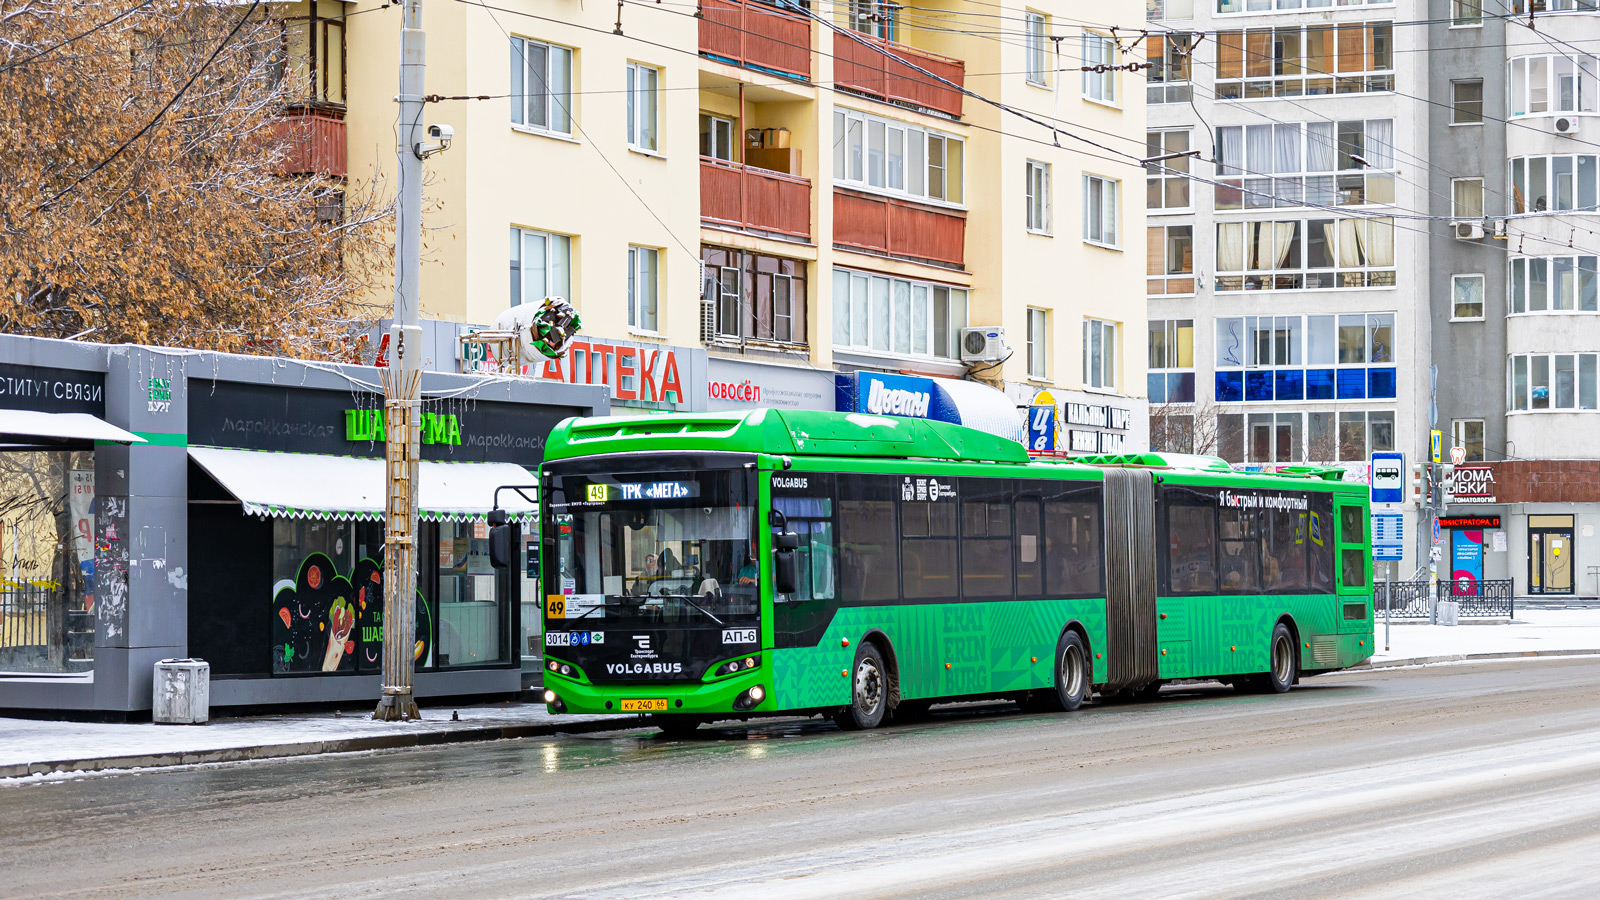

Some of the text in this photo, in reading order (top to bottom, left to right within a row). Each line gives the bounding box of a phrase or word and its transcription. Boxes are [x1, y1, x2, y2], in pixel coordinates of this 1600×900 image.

[53, 381, 102, 402] СВЯЗИ
[867, 378, 930, 418] Цветы
[1066, 403, 1108, 428] КАЛЬЯНЫ
[345, 409, 462, 445] ШАМА
[467, 433, 545, 452] марокканск
[622, 482, 689, 499] ТРК «МЕГА»
[772, 477, 808, 488] VOLGABUS
[590, 486, 604, 500] 49
[1220, 491, 1308, 513] Я быстрый и комфортный
[549, 601, 564, 615] 49
[547, 634, 568, 645] 3014
[723, 631, 755, 643] АП-6
[943, 635, 986, 663] ERIN
[606, 663, 682, 675] VOLGABUS
[945, 665, 986, 694] BURG
[637, 700, 652, 710] 240
[656, 698, 664, 706] 66
